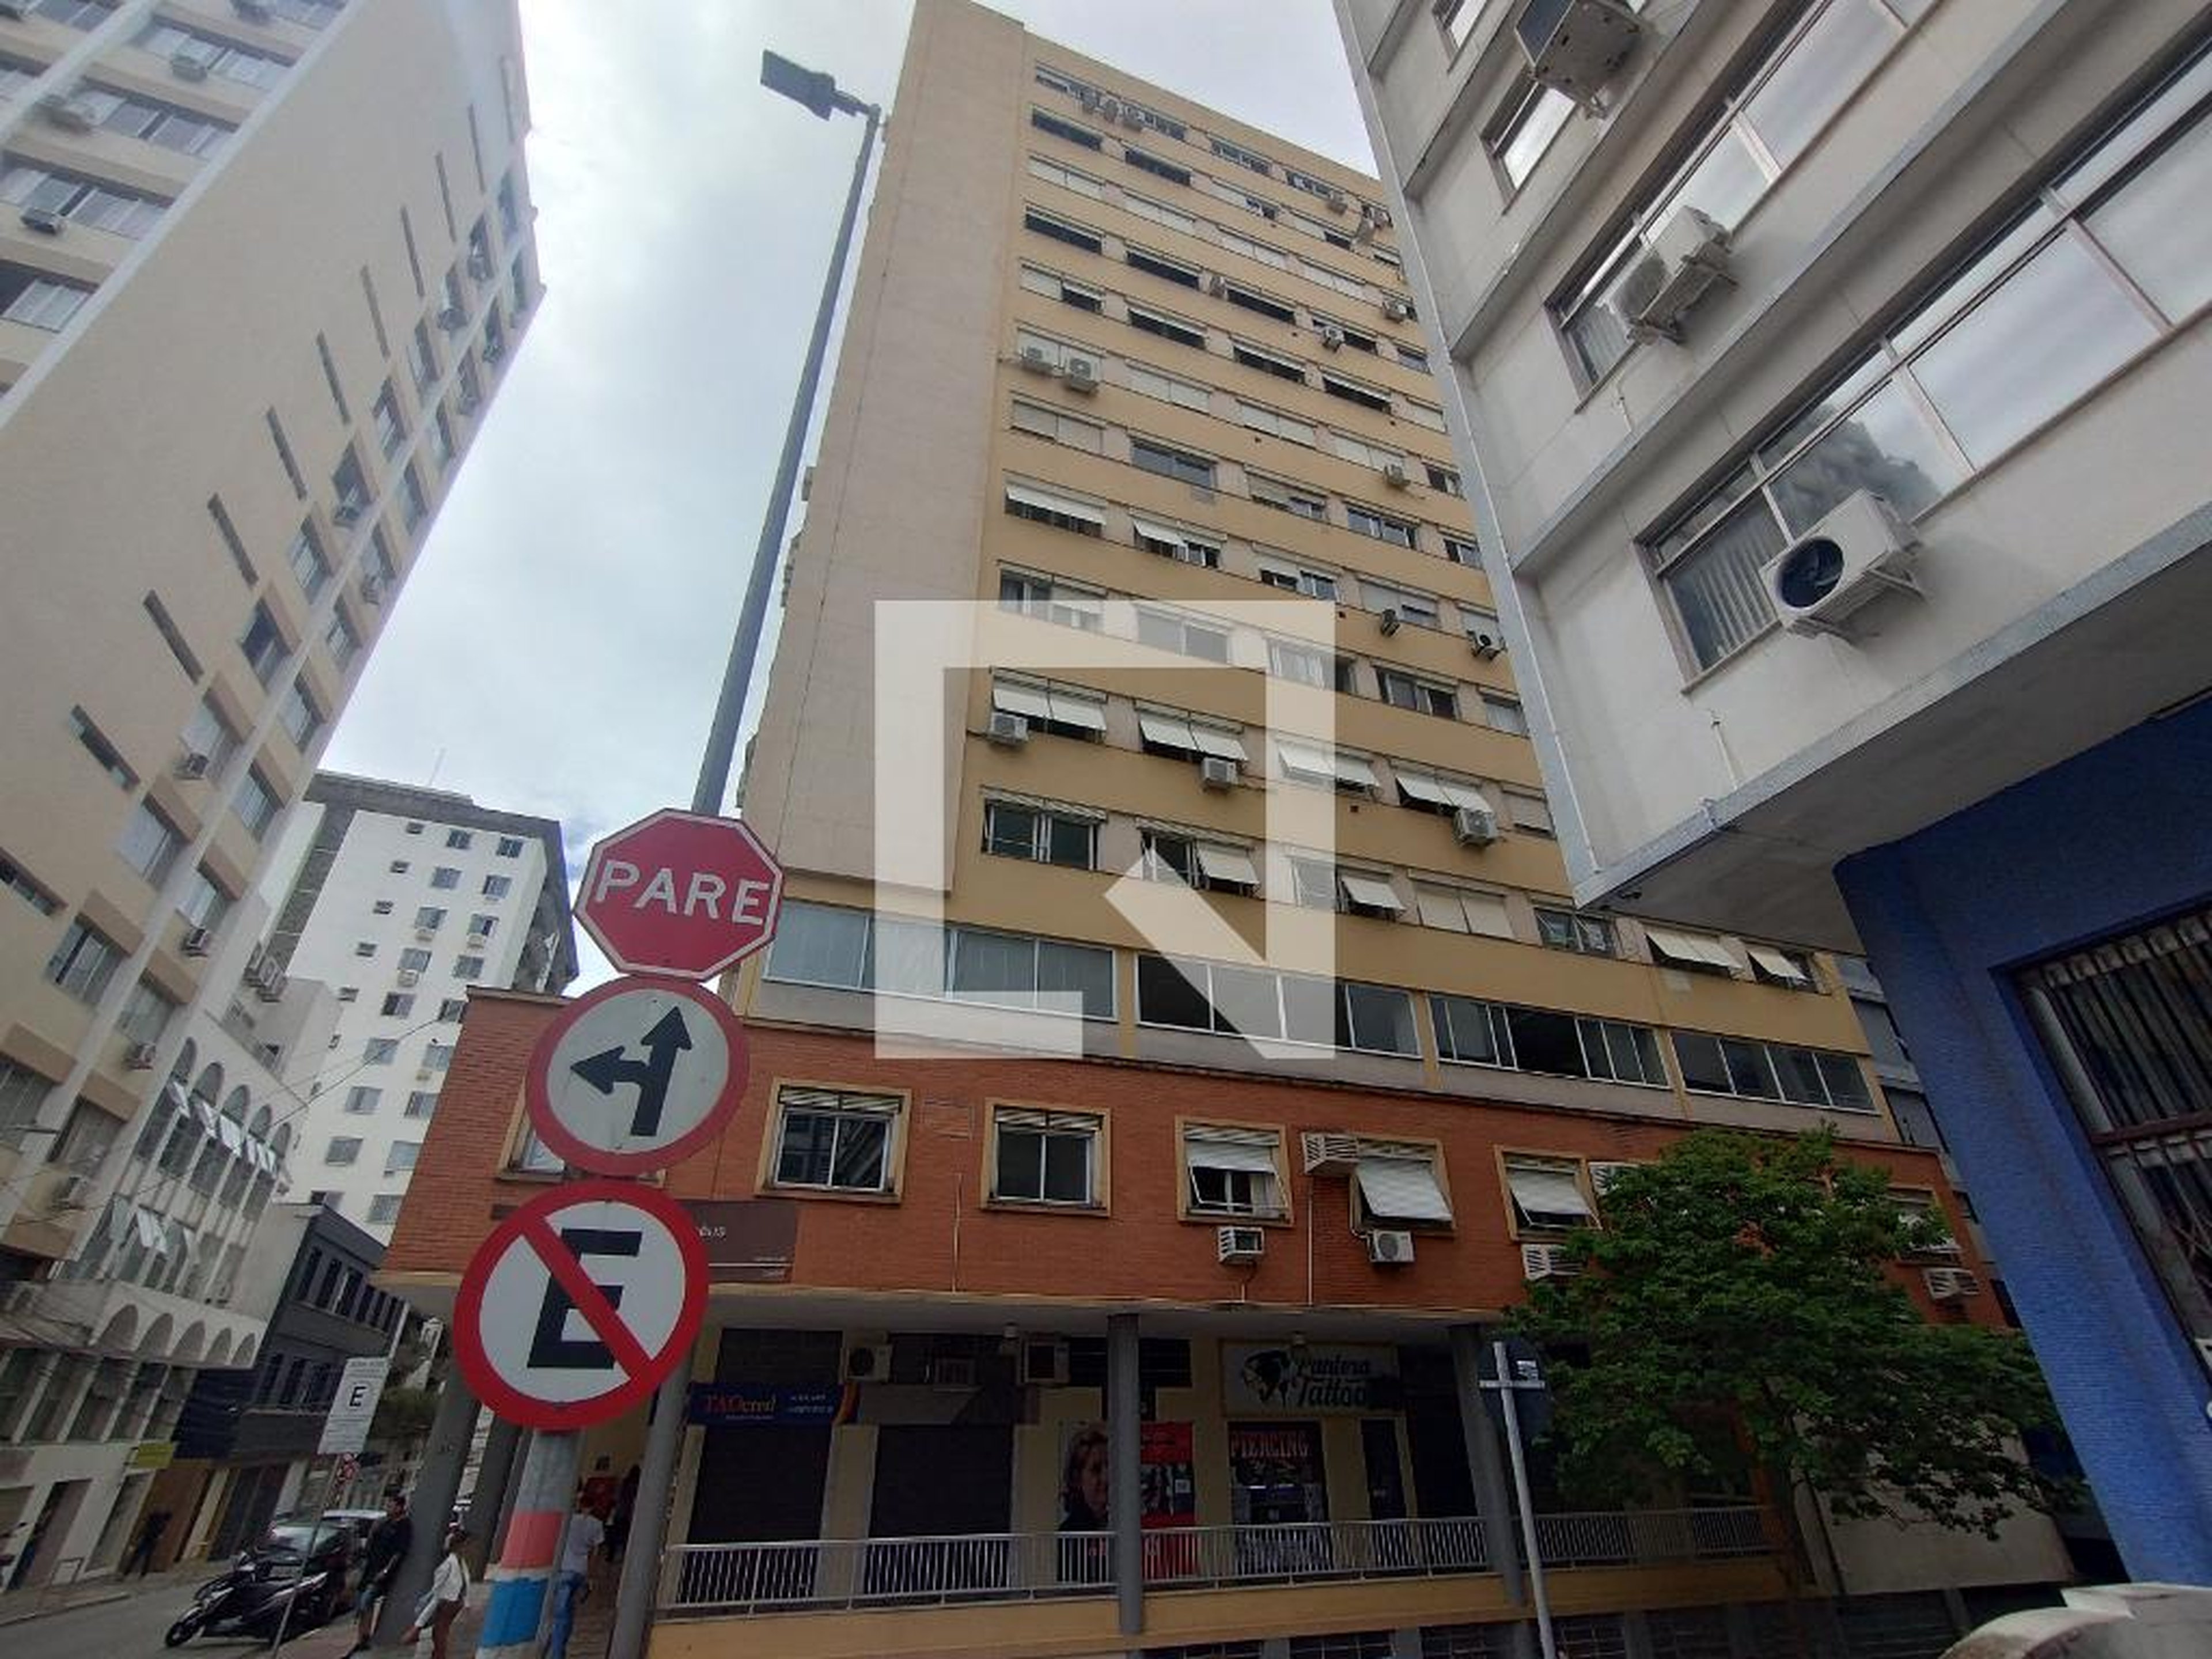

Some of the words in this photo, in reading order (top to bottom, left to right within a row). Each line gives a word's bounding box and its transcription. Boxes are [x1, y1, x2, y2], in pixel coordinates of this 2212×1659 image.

[594, 859, 770, 927] PARE
[527, 1228, 642, 1369] E
[349, 1385, 367, 1407] E
[1295, 1378, 1368, 1406] Tattoo
[1230, 1430, 1309, 1457] PIERCING
